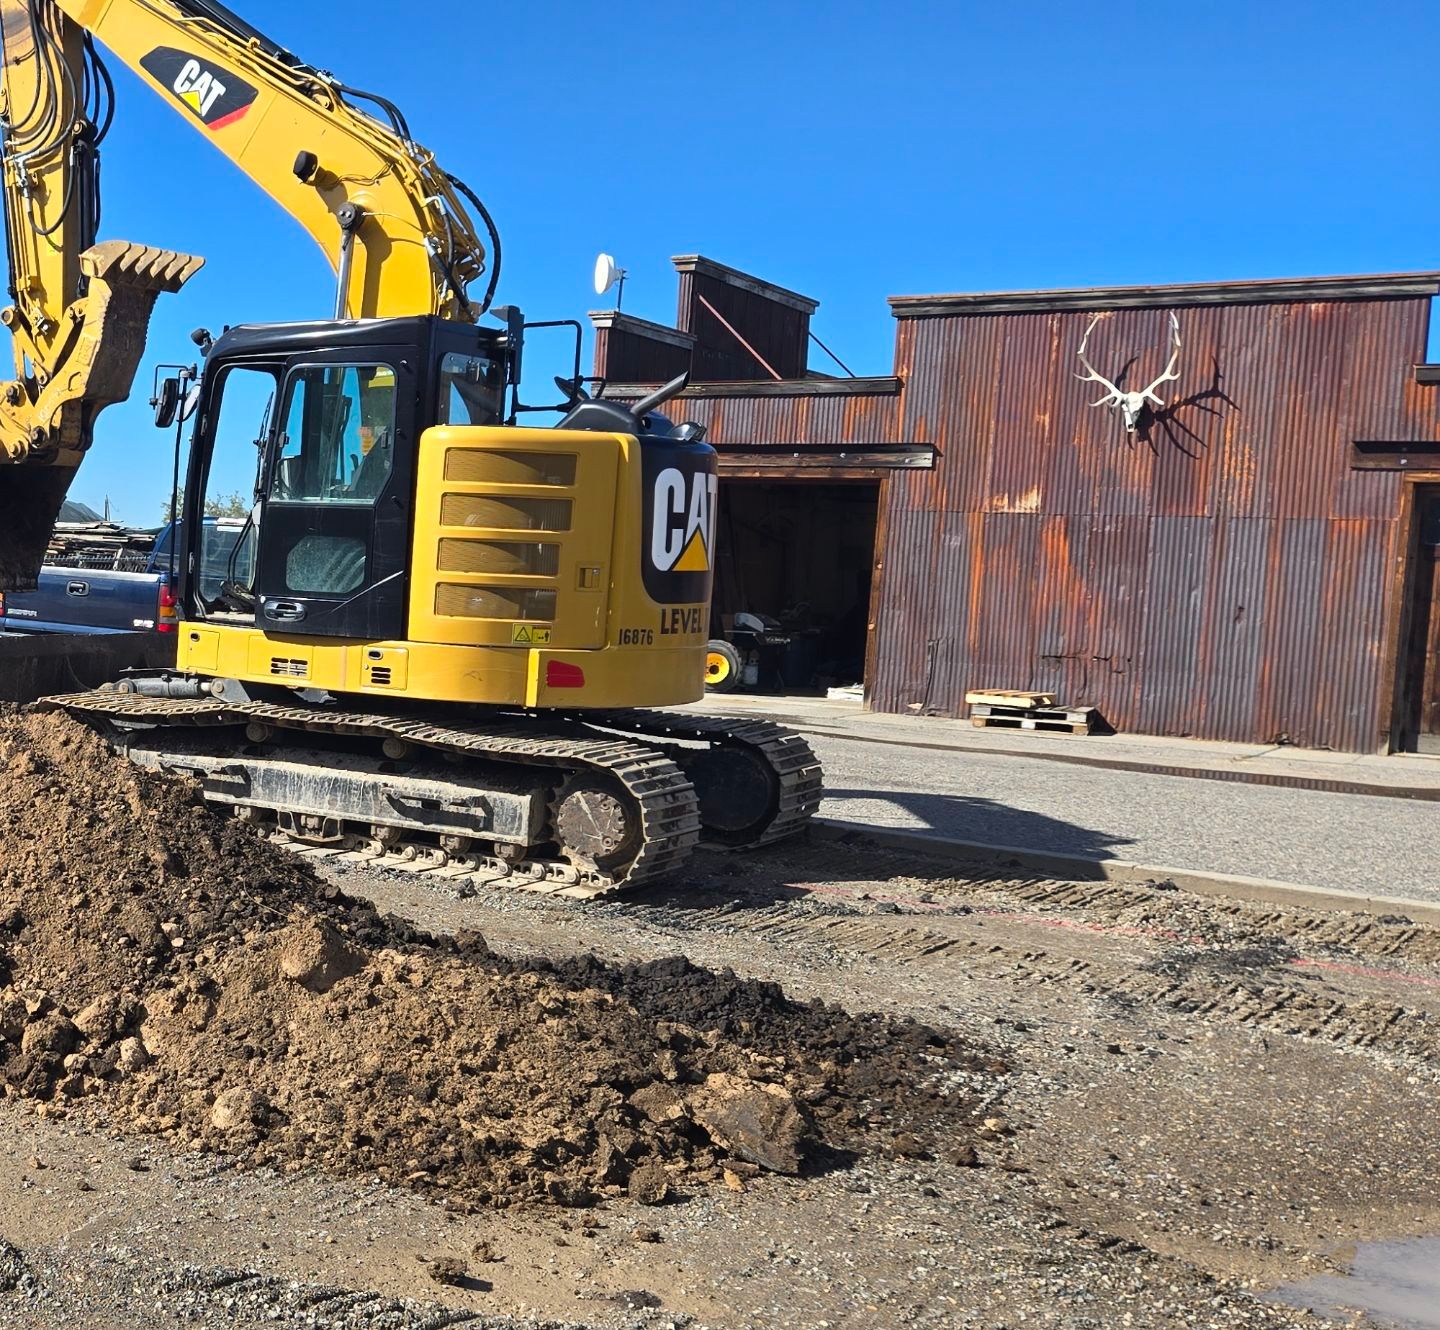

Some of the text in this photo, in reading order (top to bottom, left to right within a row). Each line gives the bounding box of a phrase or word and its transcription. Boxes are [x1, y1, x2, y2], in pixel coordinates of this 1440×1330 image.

[173, 59, 227, 117] CAT
[651, 467, 718, 571] CAT
[618, 628, 653, 645] 16876
[660, 607, 702, 634] LEVEL
